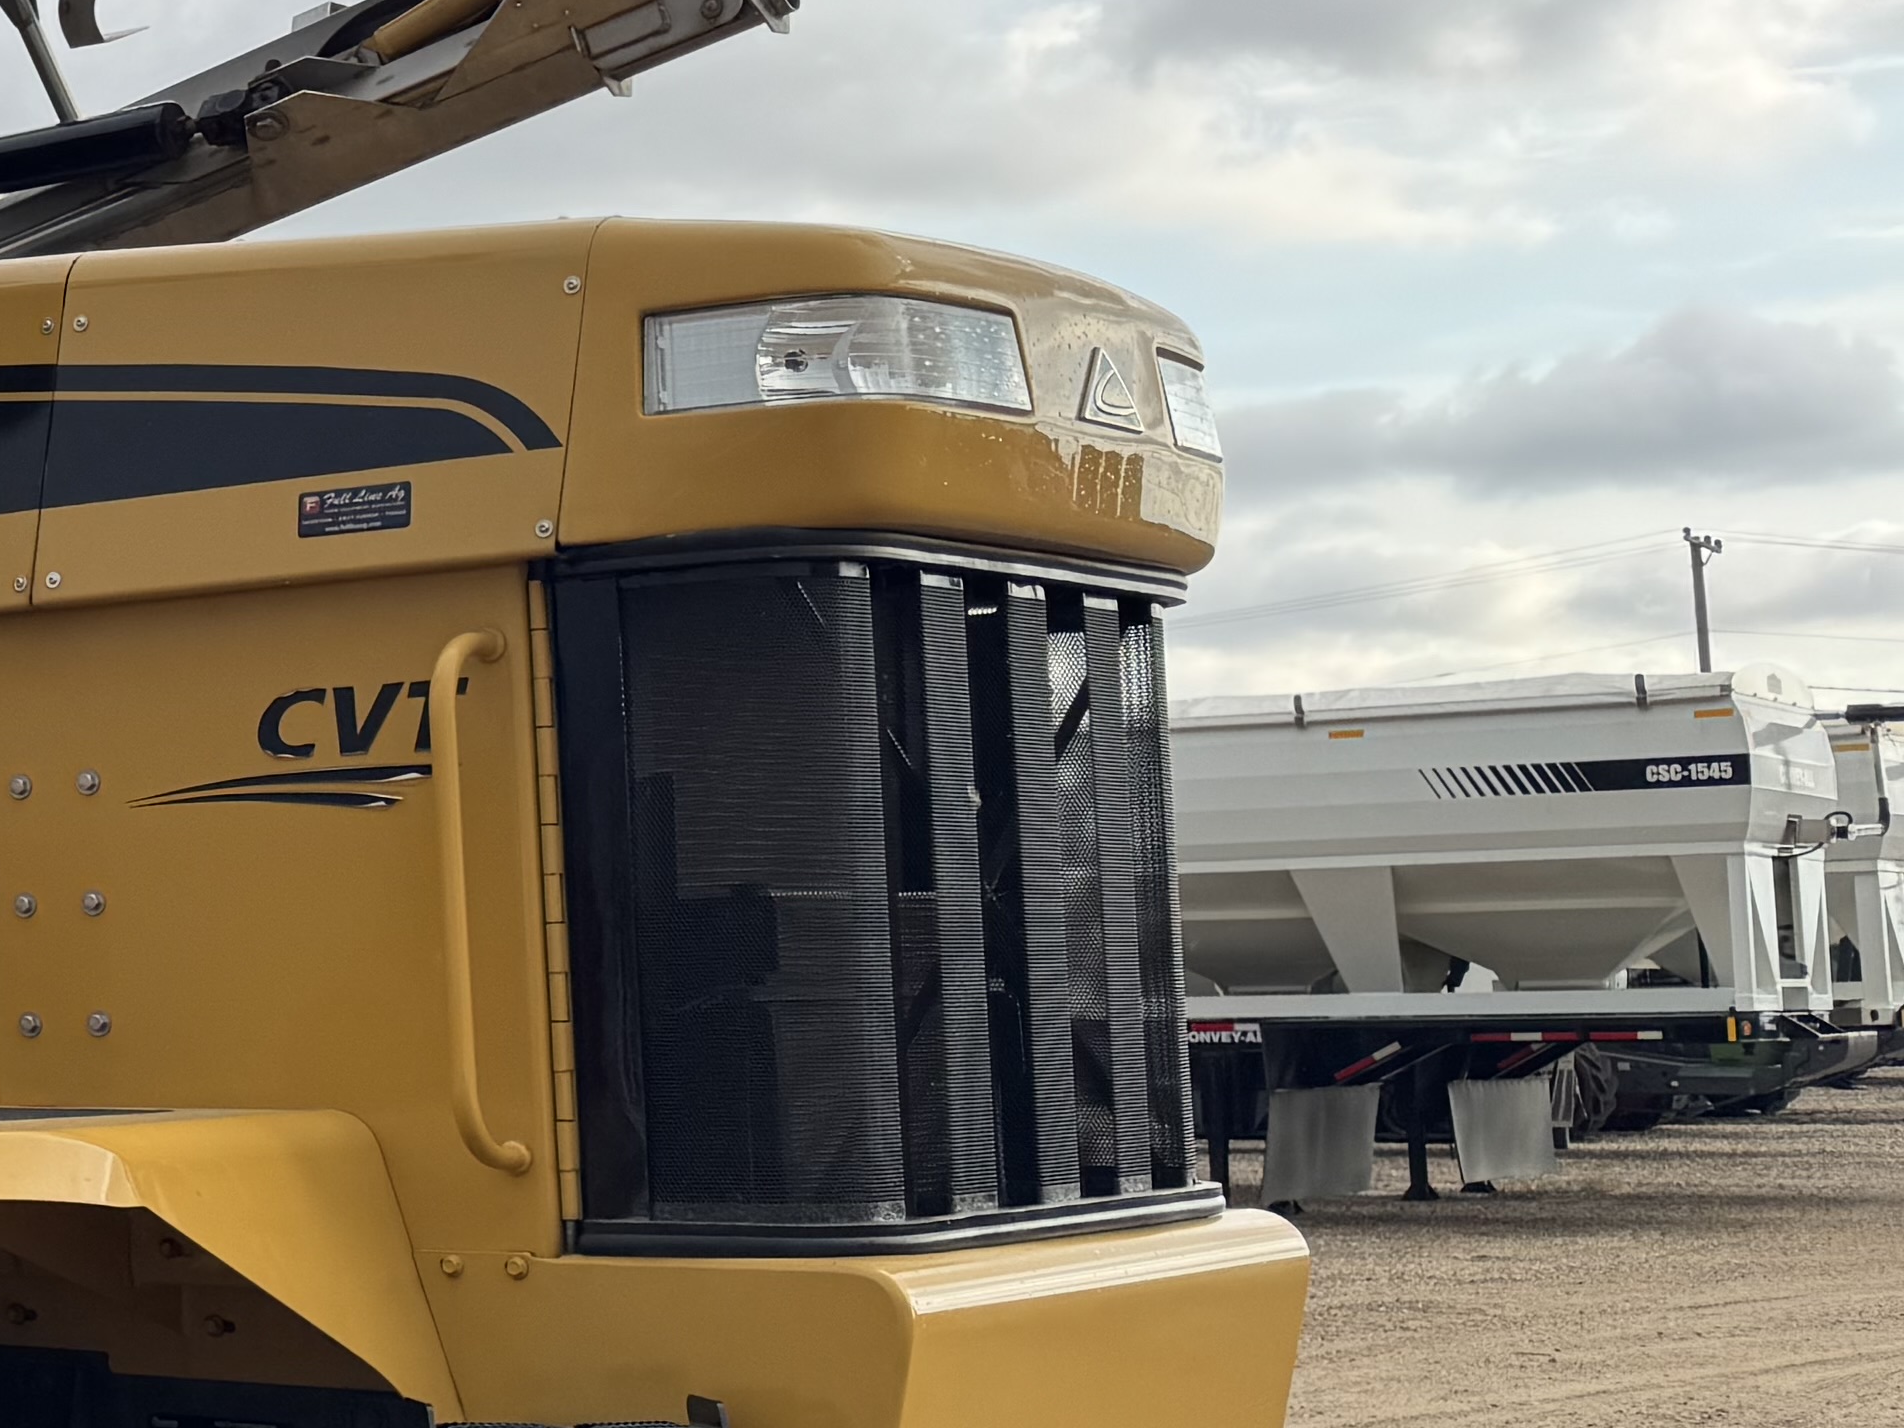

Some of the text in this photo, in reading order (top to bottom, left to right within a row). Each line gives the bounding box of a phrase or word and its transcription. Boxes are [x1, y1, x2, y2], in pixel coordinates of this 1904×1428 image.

[257, 677, 469, 760] CVT
[1645, 761, 1733, 783] CSC-1545
[1189, 1031, 1262, 1044] ONVEY-A
